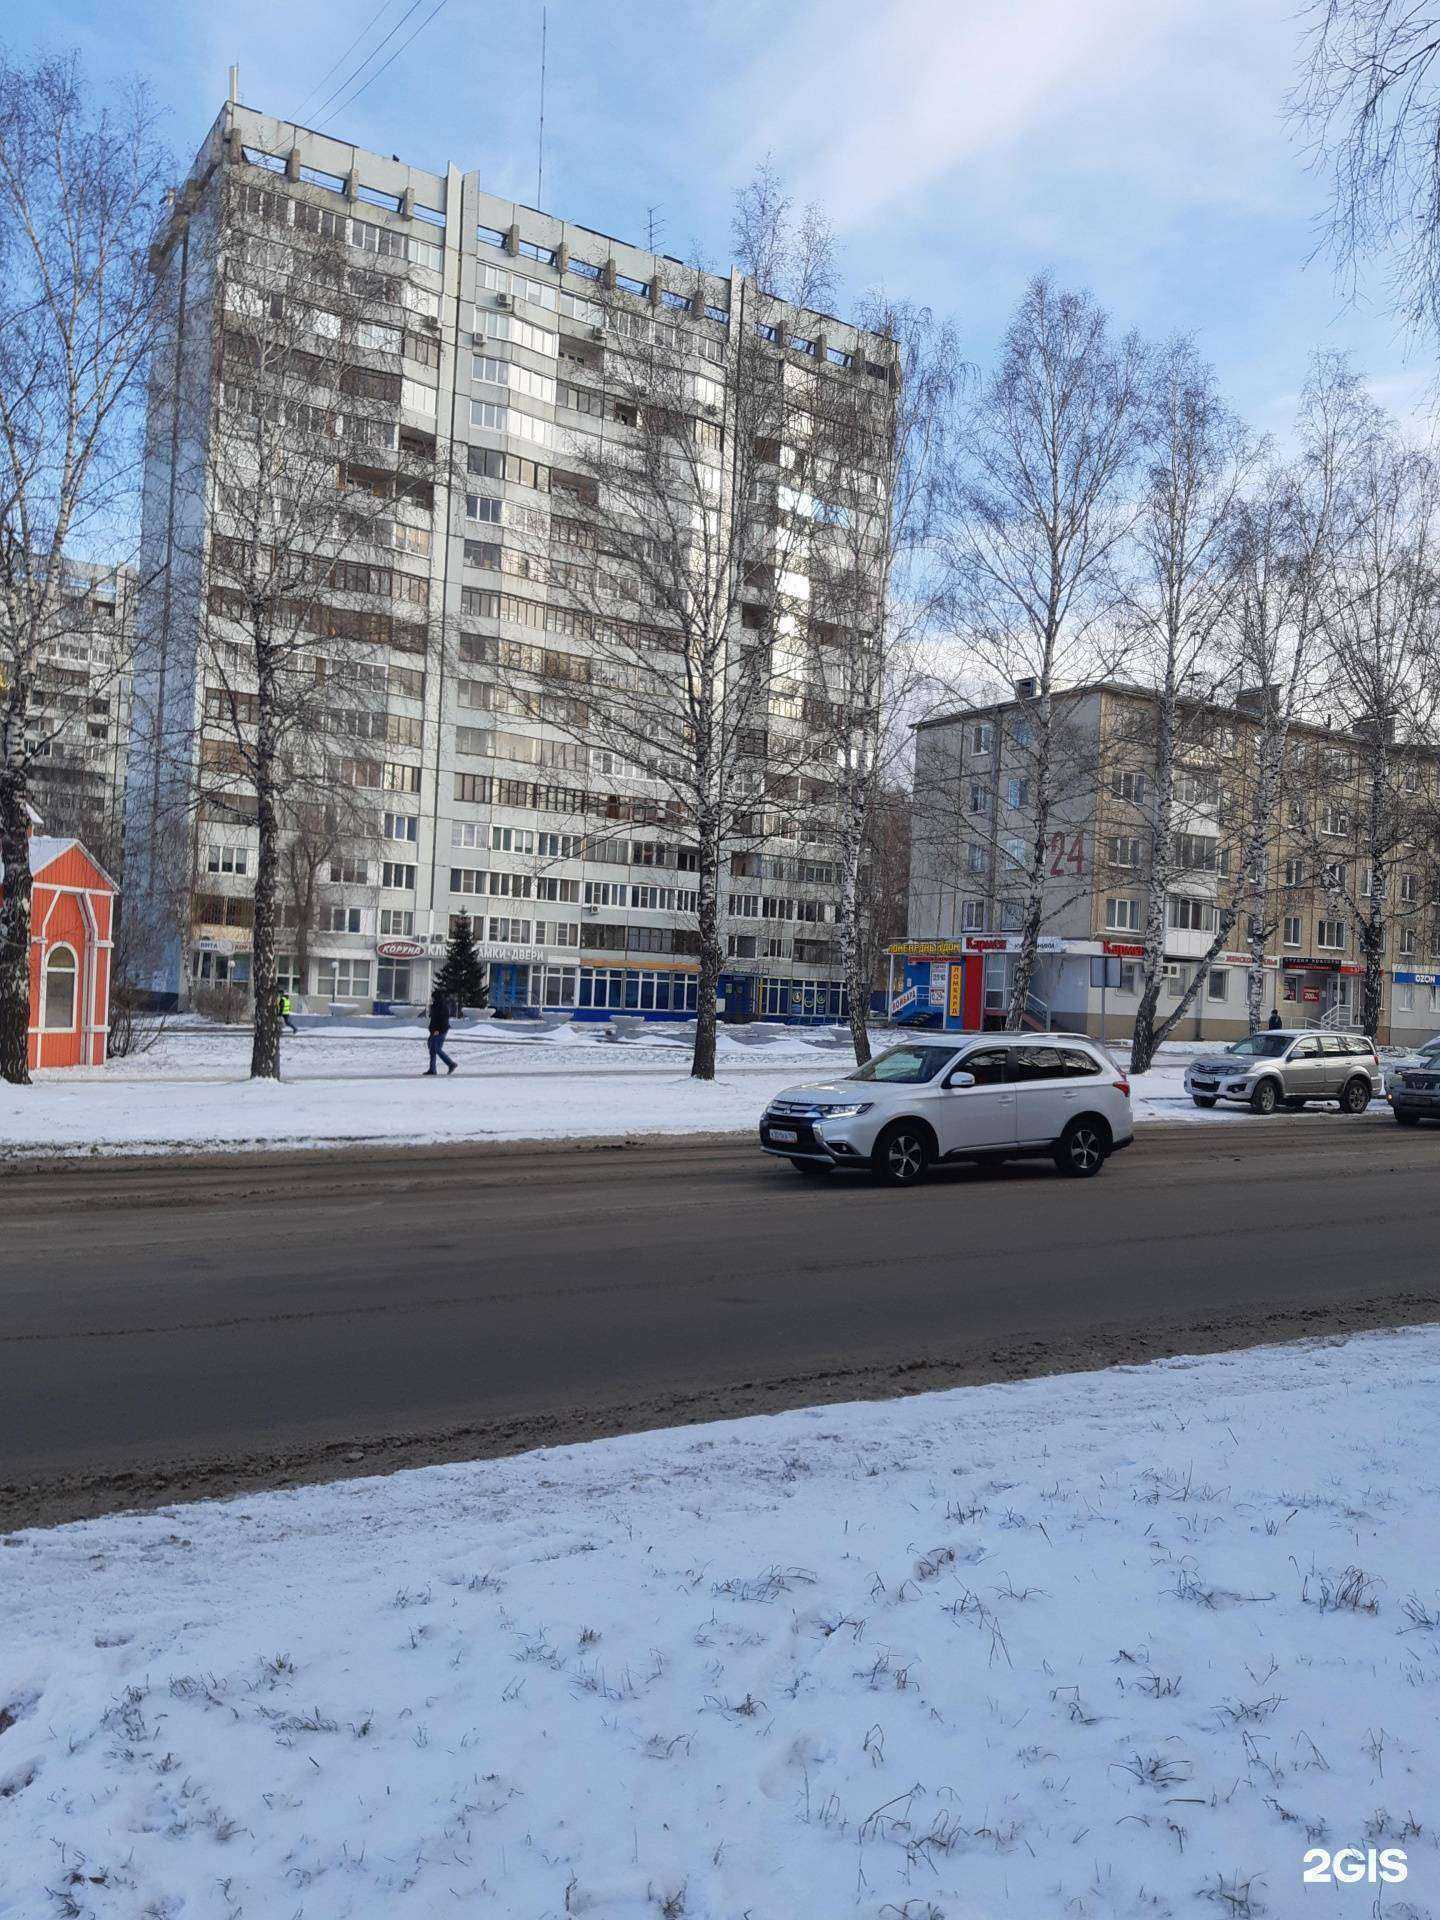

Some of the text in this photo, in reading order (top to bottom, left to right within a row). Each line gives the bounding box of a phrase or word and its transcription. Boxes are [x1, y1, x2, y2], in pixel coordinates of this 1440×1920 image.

[1050, 831, 1083, 876] 24
[478, 947, 506, 959] АМКИ
[511, 948, 544, 961] ДВЕРИ
[951, 967, 960, 1014] ЛОМБАРД
[1415, 974, 1436, 984] OZON
